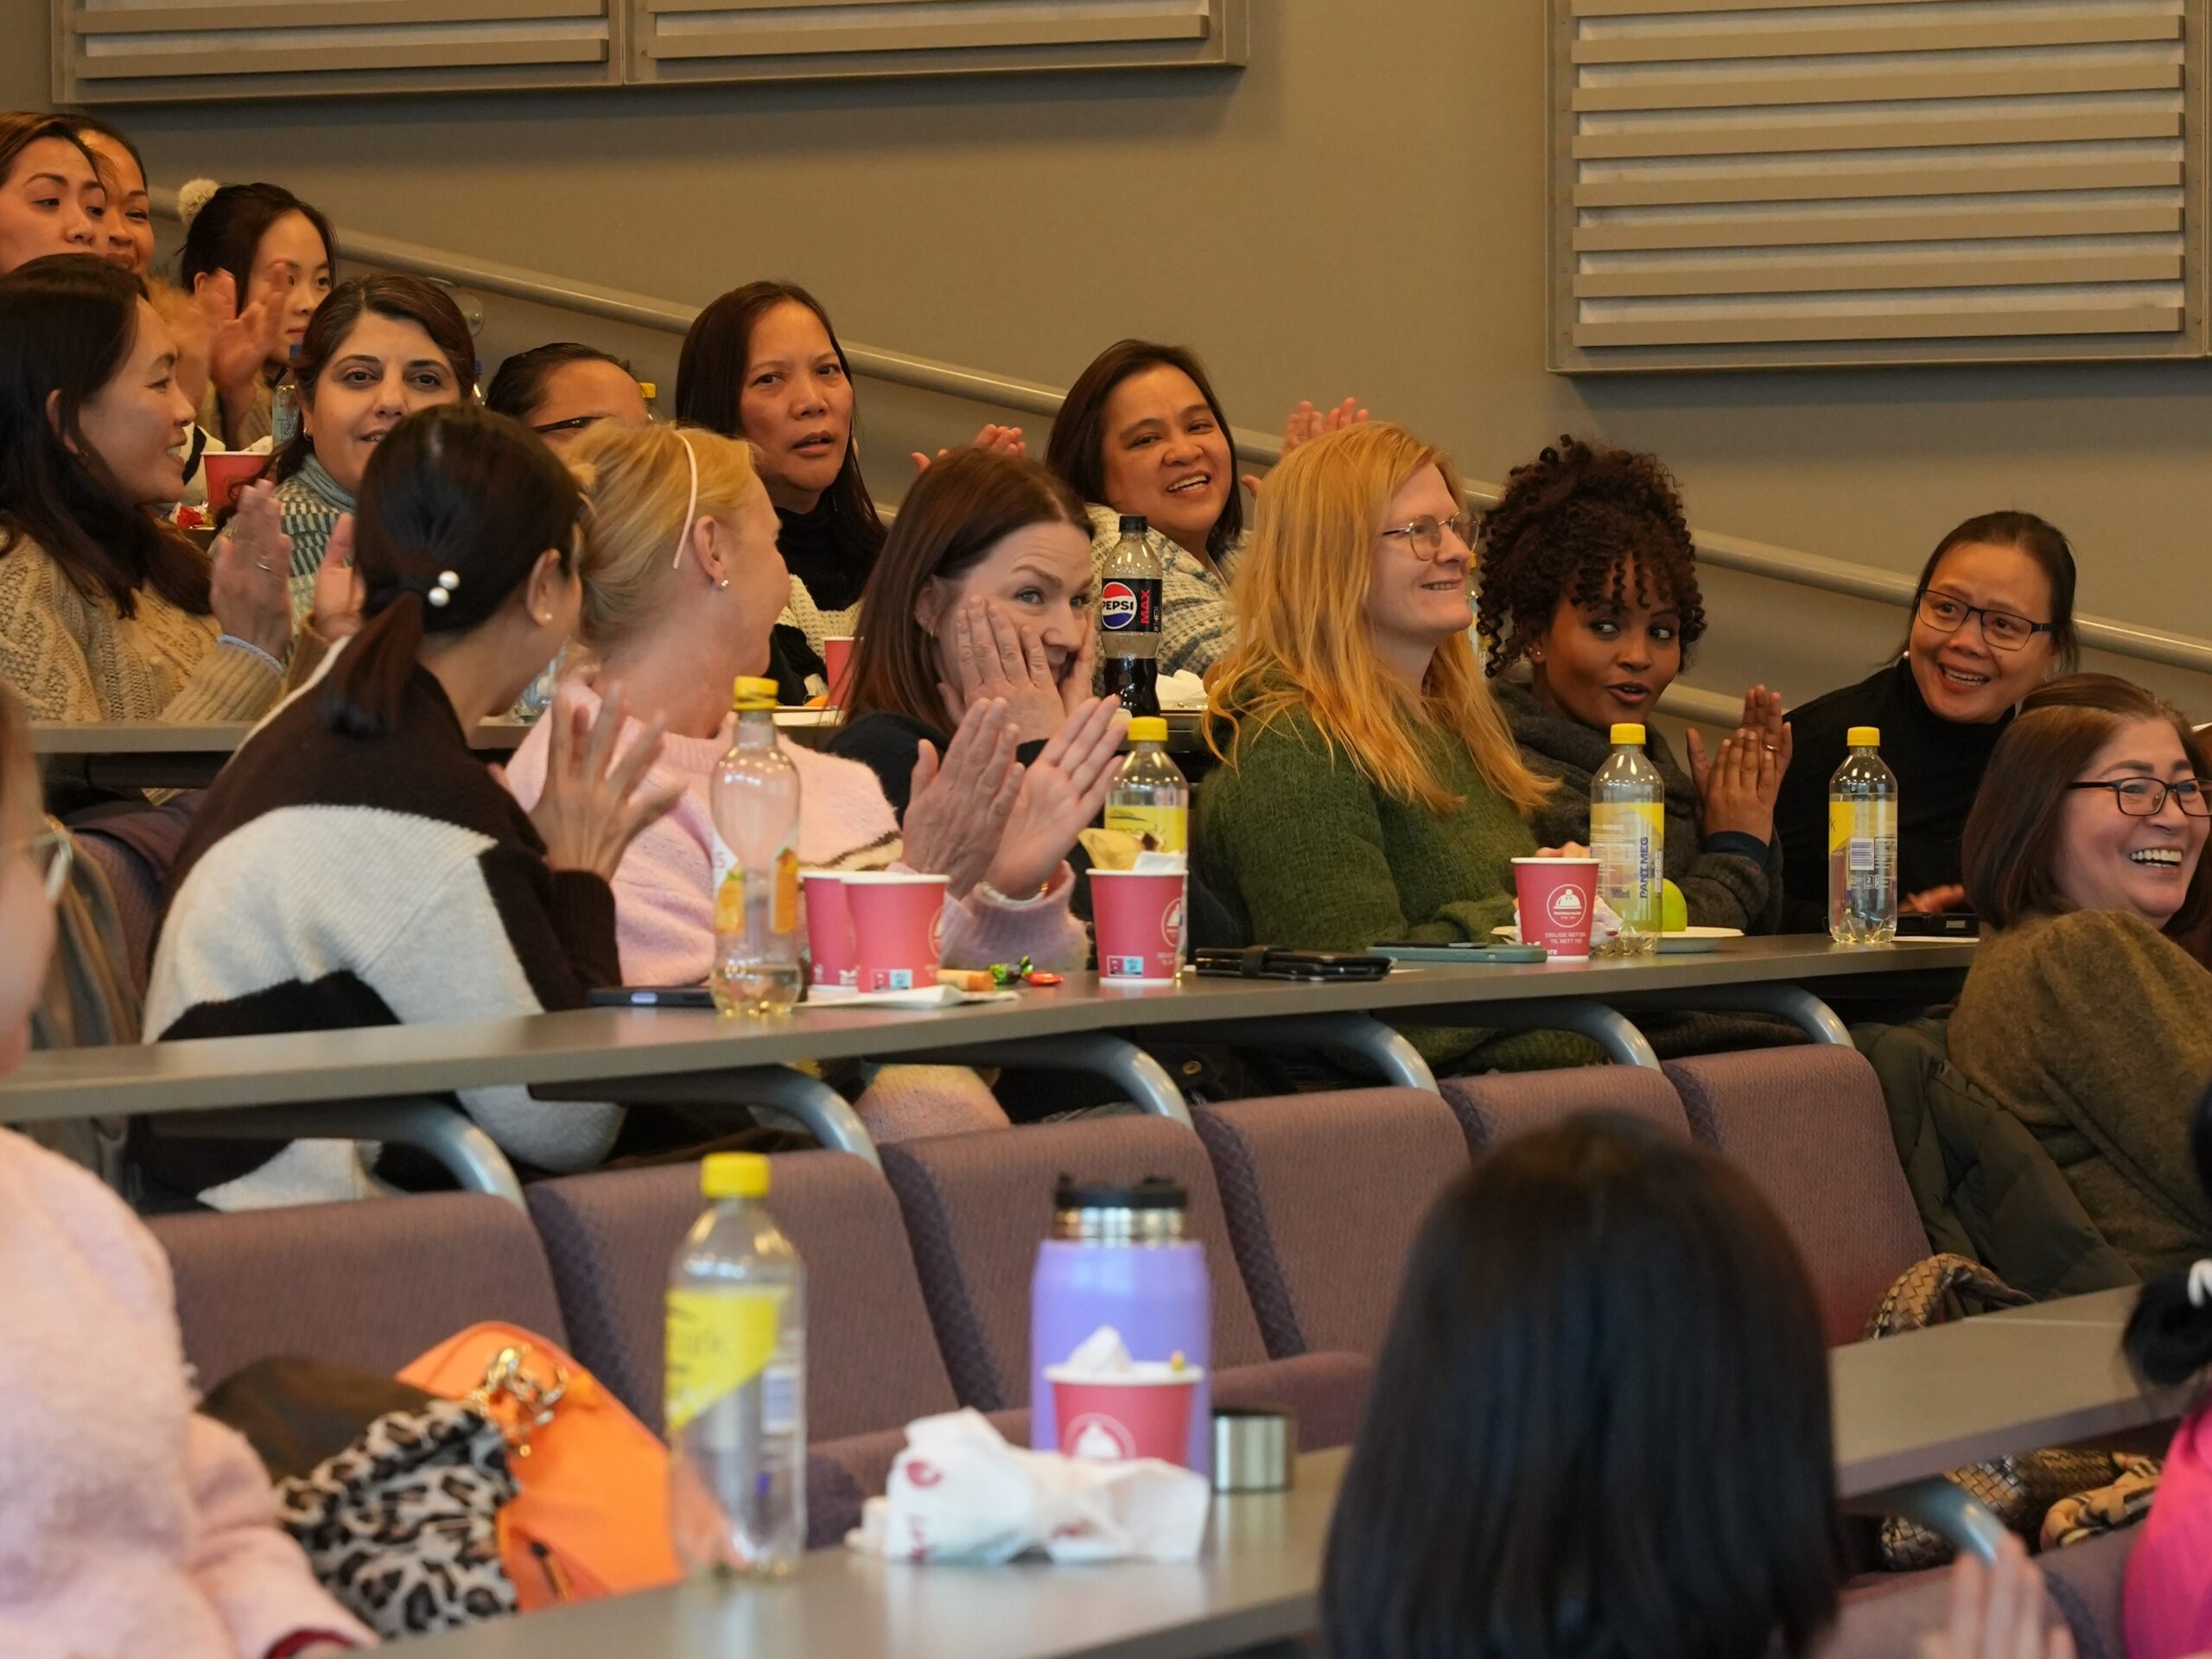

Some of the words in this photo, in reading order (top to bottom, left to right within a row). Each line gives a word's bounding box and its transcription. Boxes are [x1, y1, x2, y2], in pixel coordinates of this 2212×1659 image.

[1103, 601, 1134, 610] PEPSI
[1141, 589, 1150, 624] MAX
[1640, 836, 1649, 864] MEG
[1639, 864, 1649, 899] PANT
